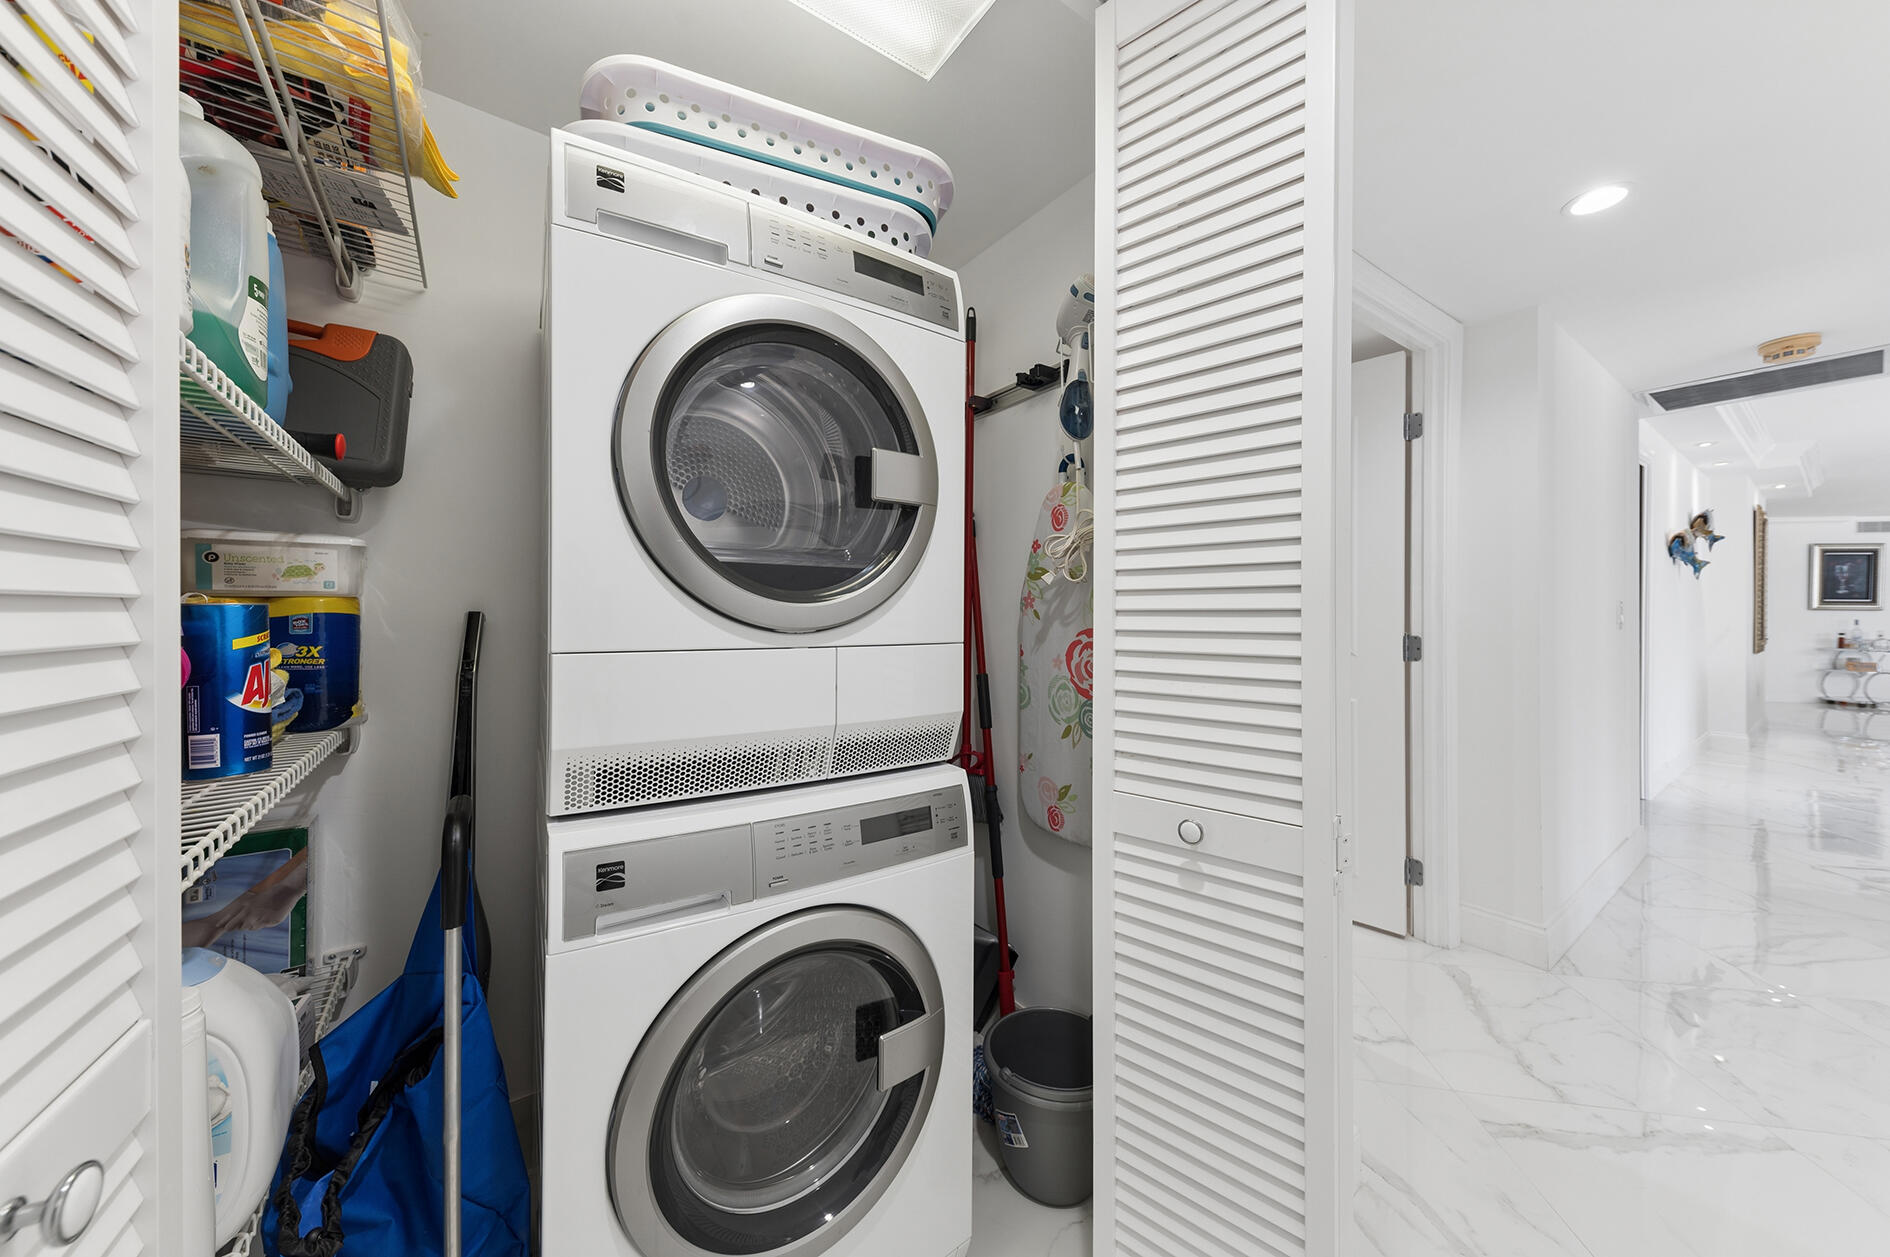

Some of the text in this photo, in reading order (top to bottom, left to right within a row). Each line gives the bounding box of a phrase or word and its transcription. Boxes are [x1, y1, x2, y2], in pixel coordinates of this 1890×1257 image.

[598, 167, 624, 179] Kenmore
[223, 552, 285, 564] Unscented
[295, 645, 323, 658] 3X
[241, 659, 270, 709] AJ
[598, 864, 624, 873] Kenmore
